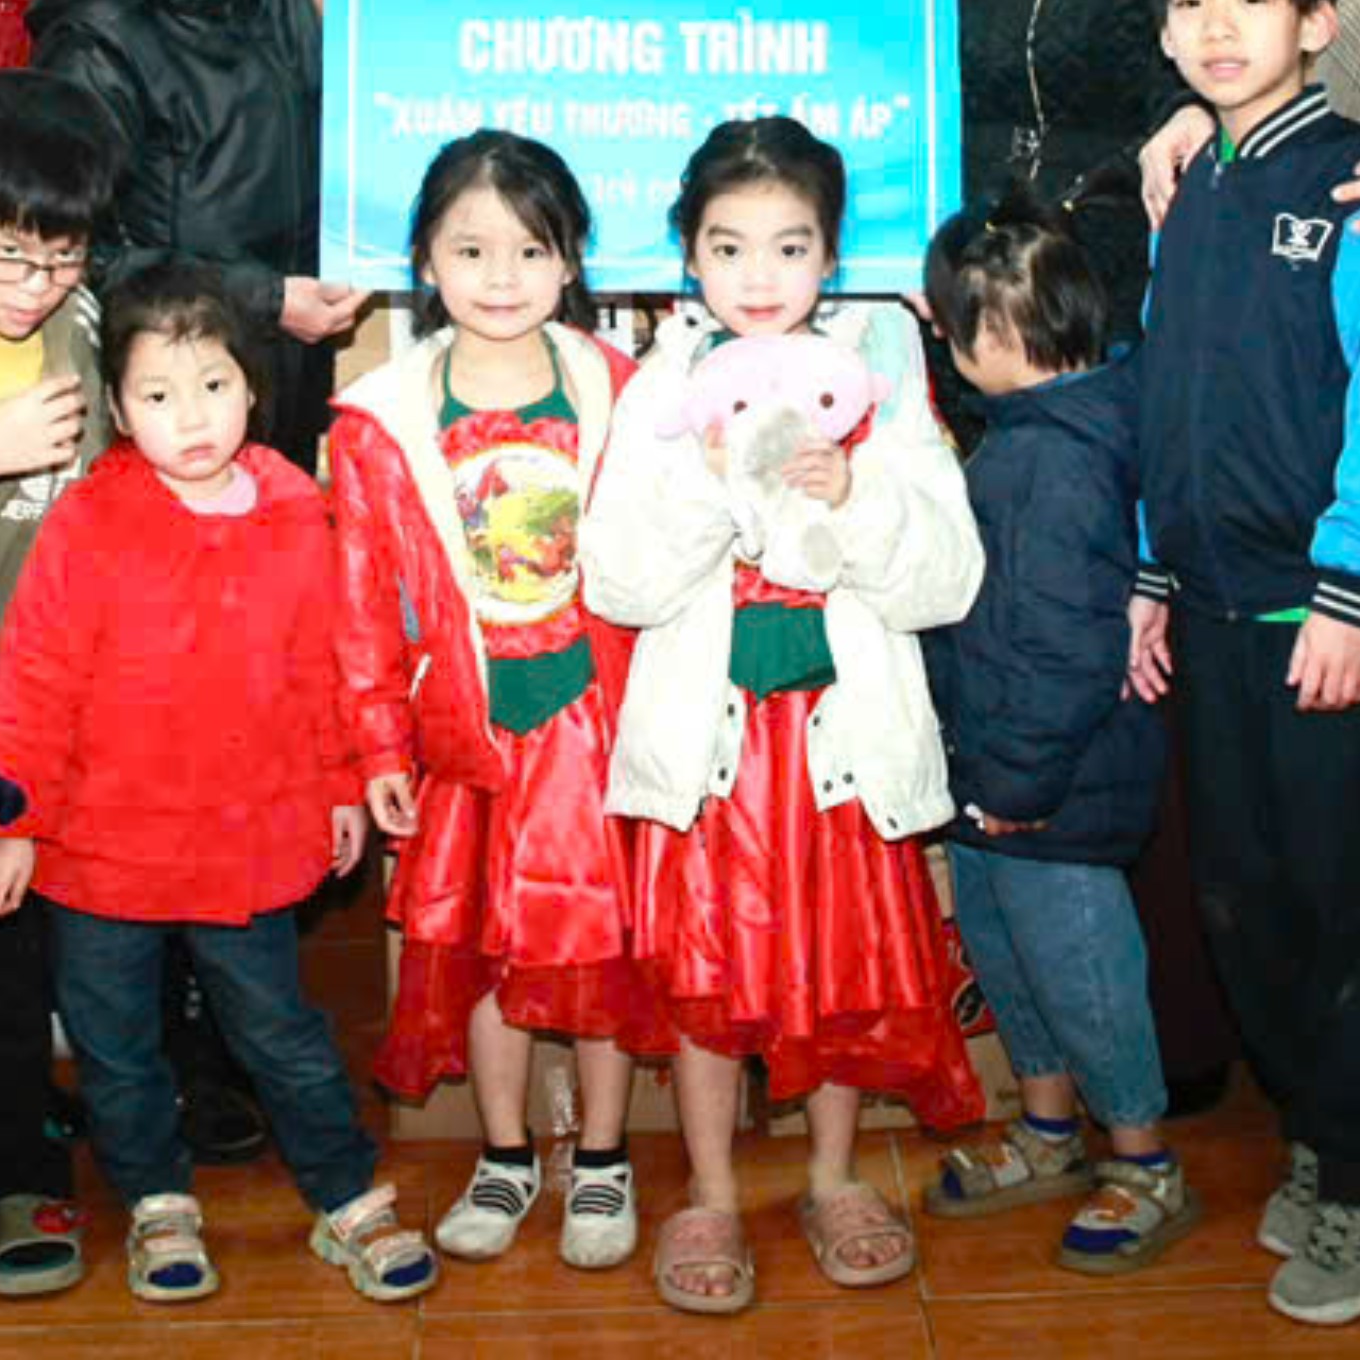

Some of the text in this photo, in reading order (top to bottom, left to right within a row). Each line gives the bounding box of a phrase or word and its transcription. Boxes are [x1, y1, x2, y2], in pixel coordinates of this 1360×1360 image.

[458, 7, 830, 75] CHƯƠNG TRÌNH
[493, 92, 555, 136] YÊU
[563, 95, 693, 138] THƯƠNG
